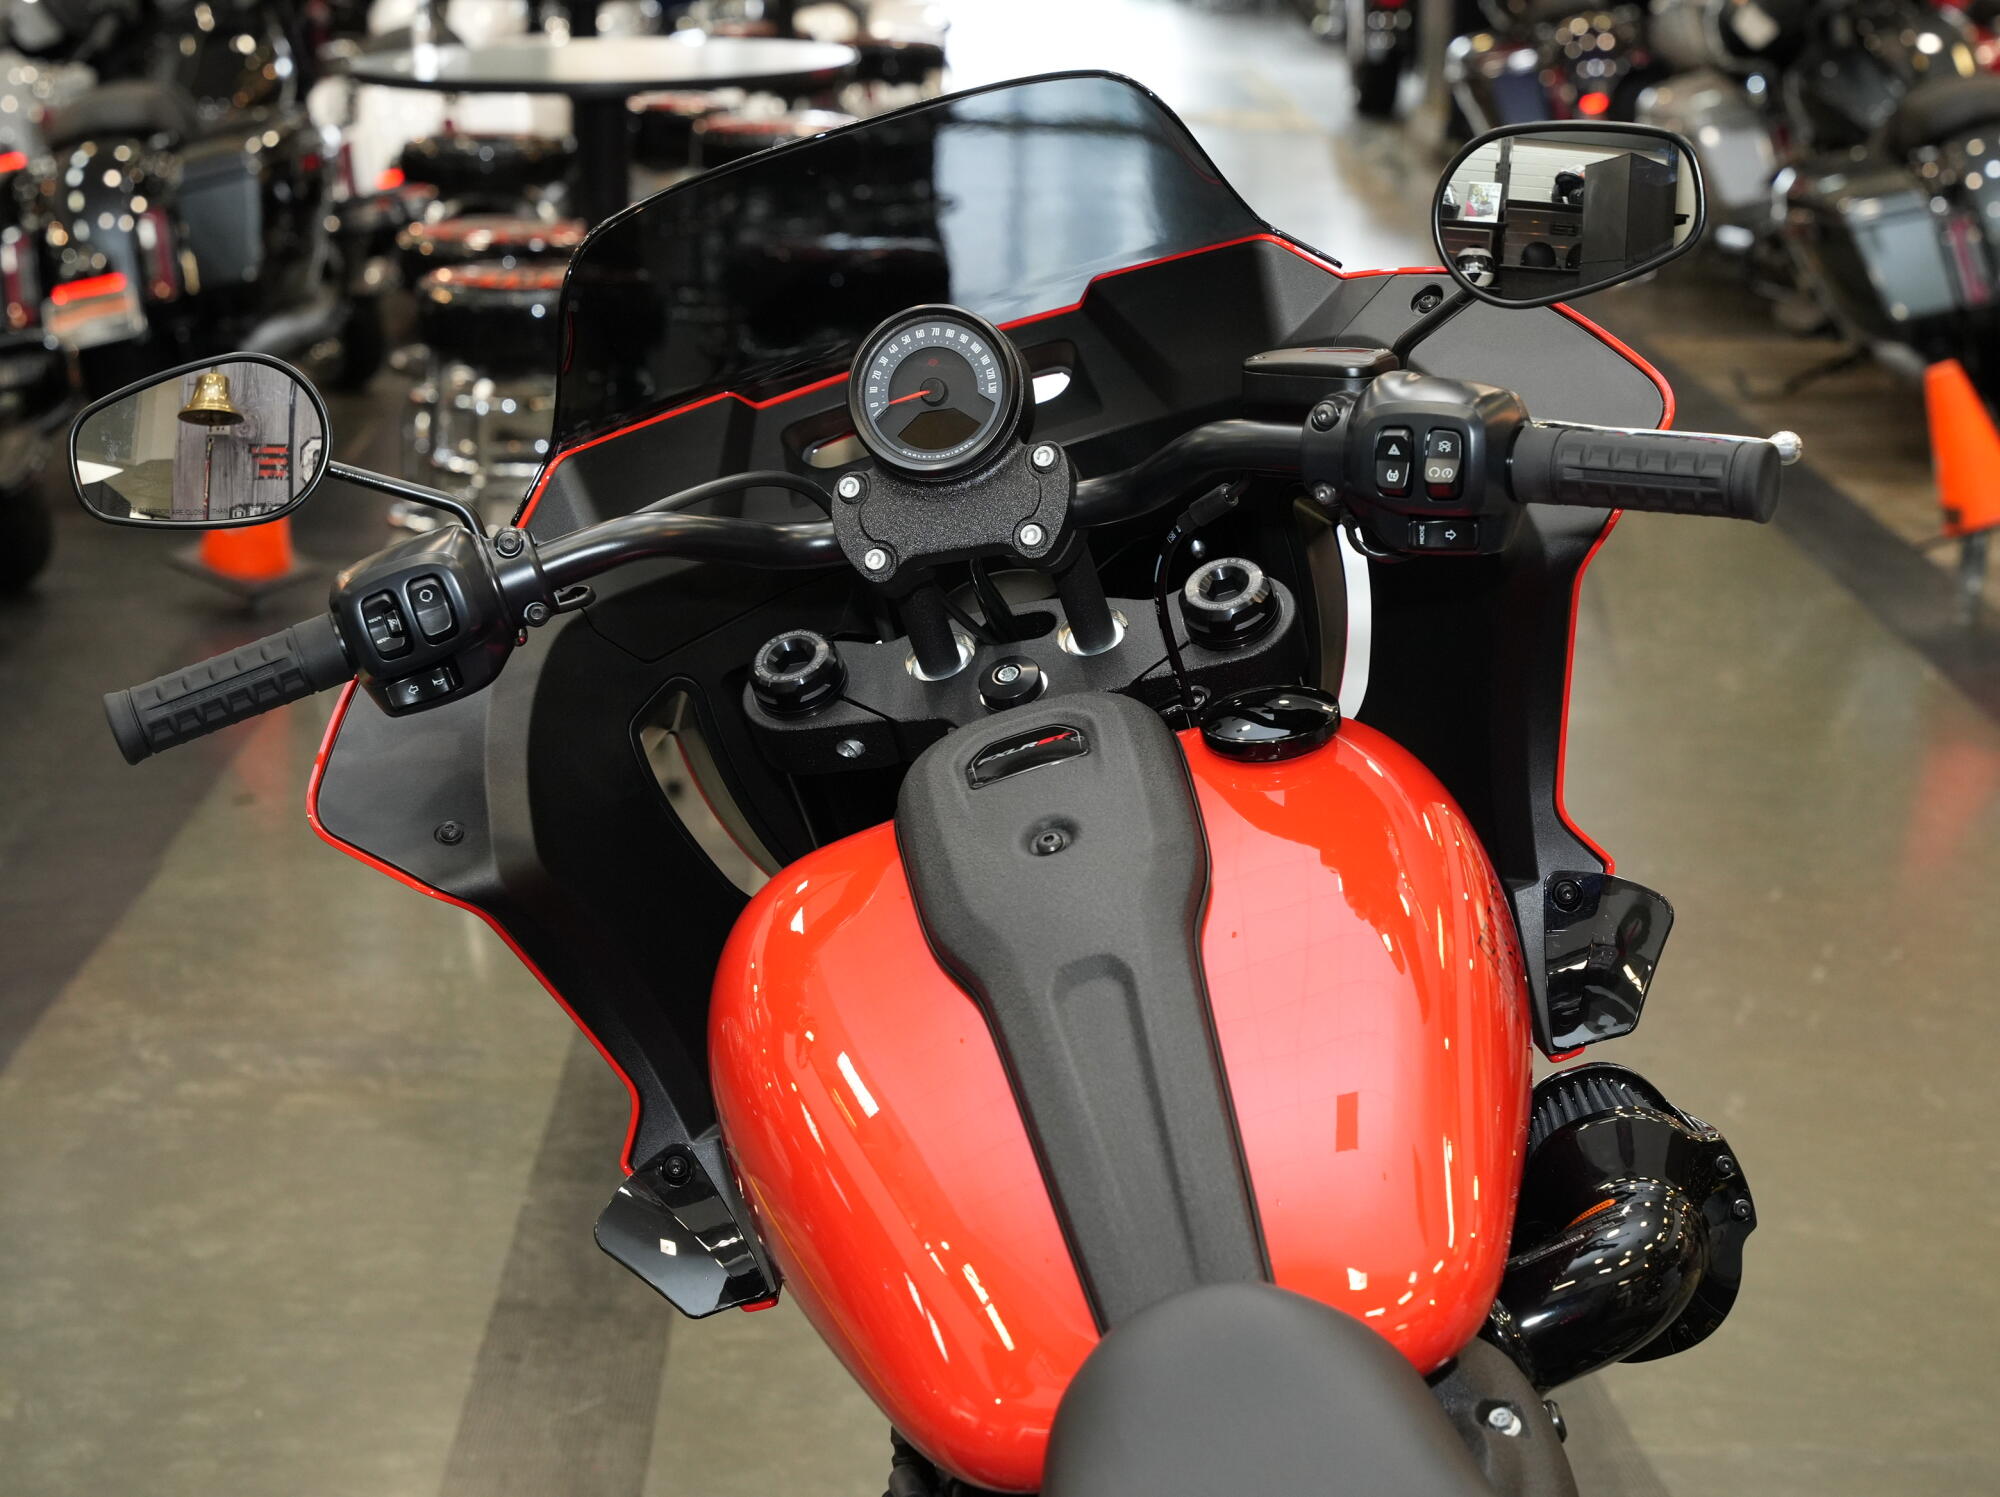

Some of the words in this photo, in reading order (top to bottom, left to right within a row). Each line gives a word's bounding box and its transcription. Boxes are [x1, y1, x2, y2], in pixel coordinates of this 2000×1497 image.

[915, 329, 925, 338] 60
[931, 328, 940, 336] 70
[945, 328, 955, 337] 80
[901, 334, 911, 345] 50
[959, 334, 969, 344] 90
[888, 344, 898, 354] 40
[879, 356, 889, 366] 30
[872, 370, 881, 380] 20
[986, 368, 996, 380] 120
